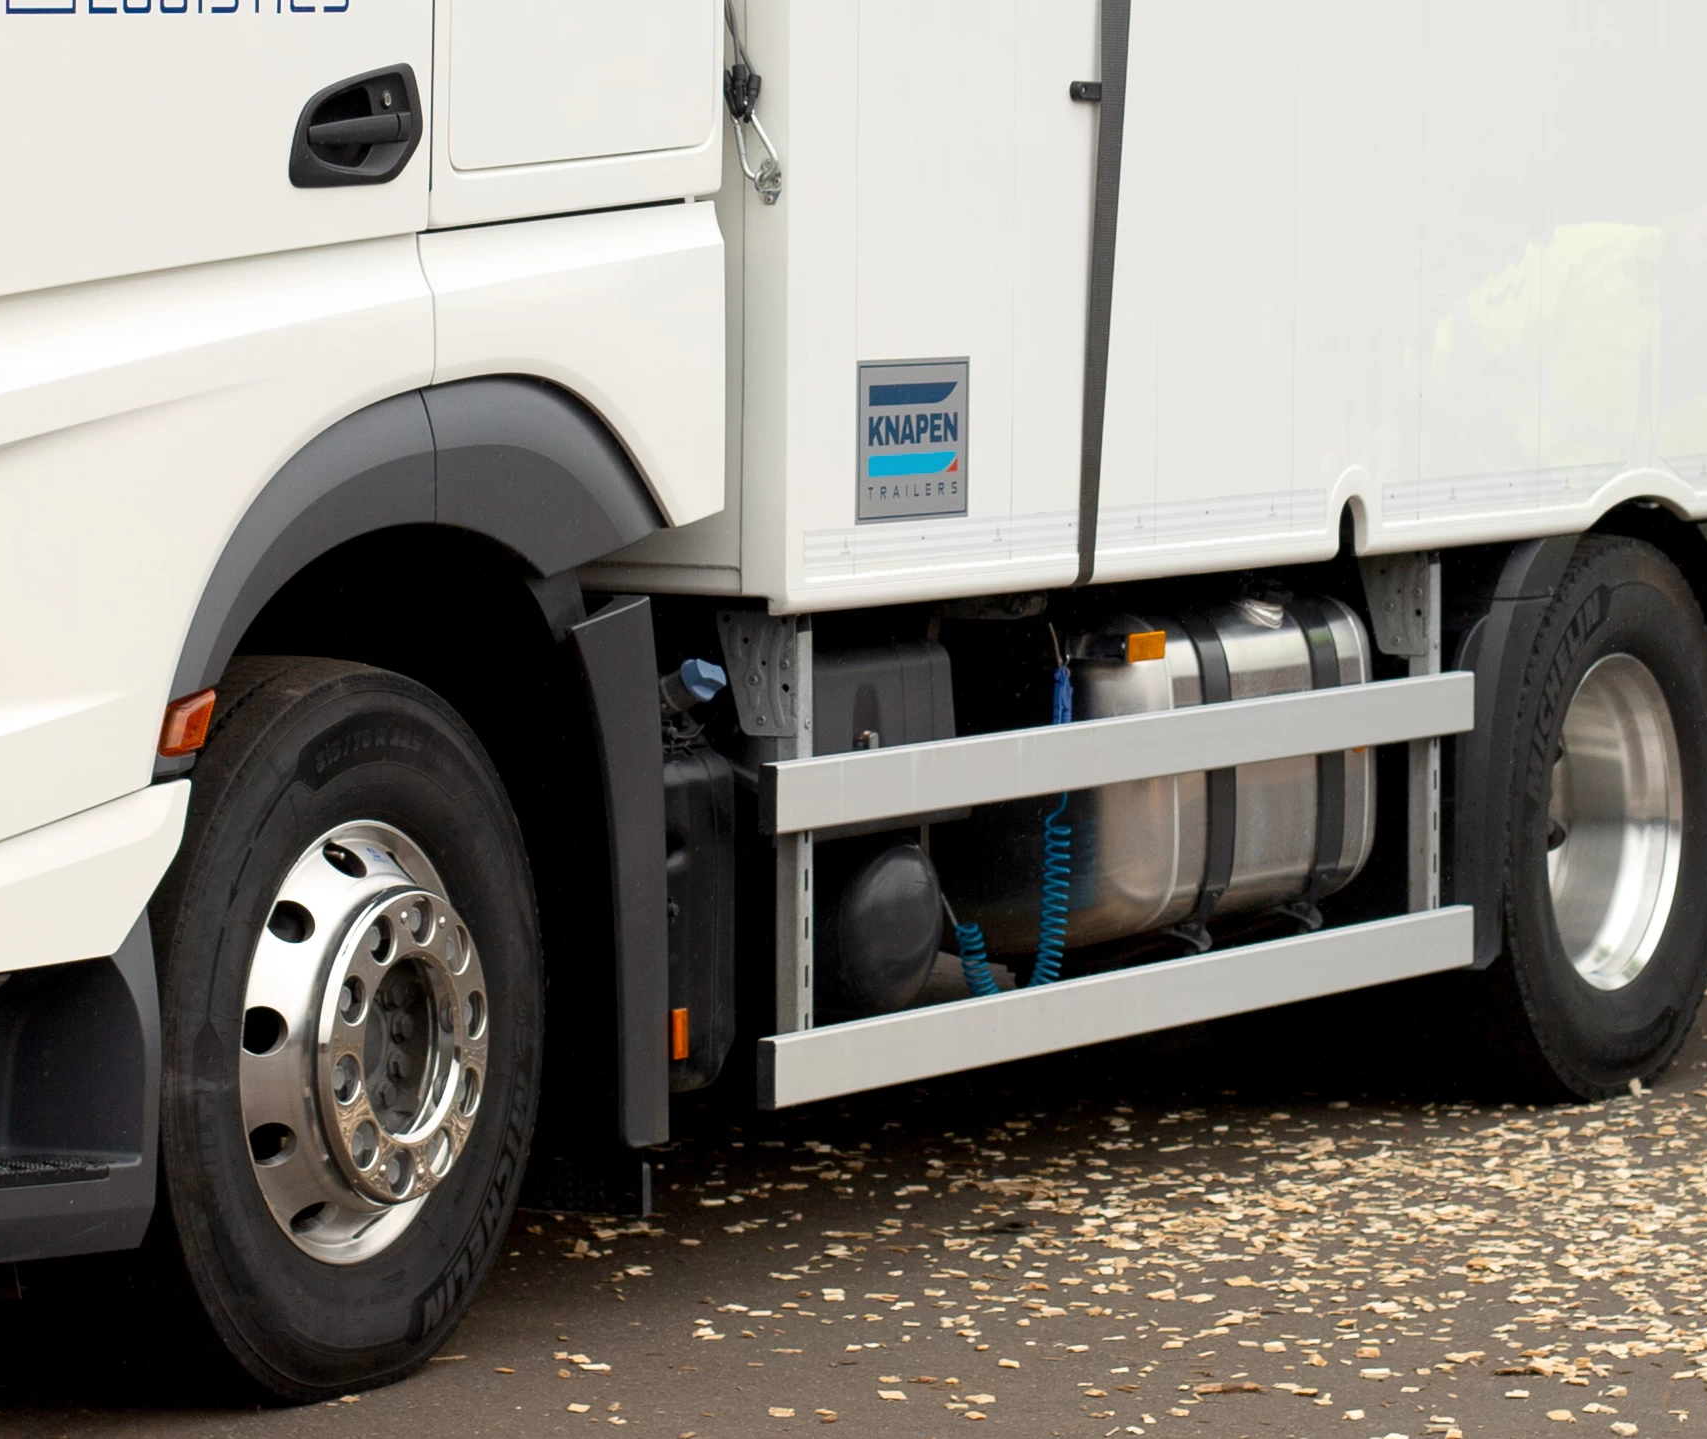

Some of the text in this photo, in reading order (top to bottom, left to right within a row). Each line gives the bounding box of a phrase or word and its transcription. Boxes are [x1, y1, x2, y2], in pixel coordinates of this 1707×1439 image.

[868, 412, 958, 446] KNAPEN
[868, 481, 958, 500] TRAILERS
[1525, 589, 1603, 800] MICHELIN
[421, 1070, 531, 1338] MICHELIN
